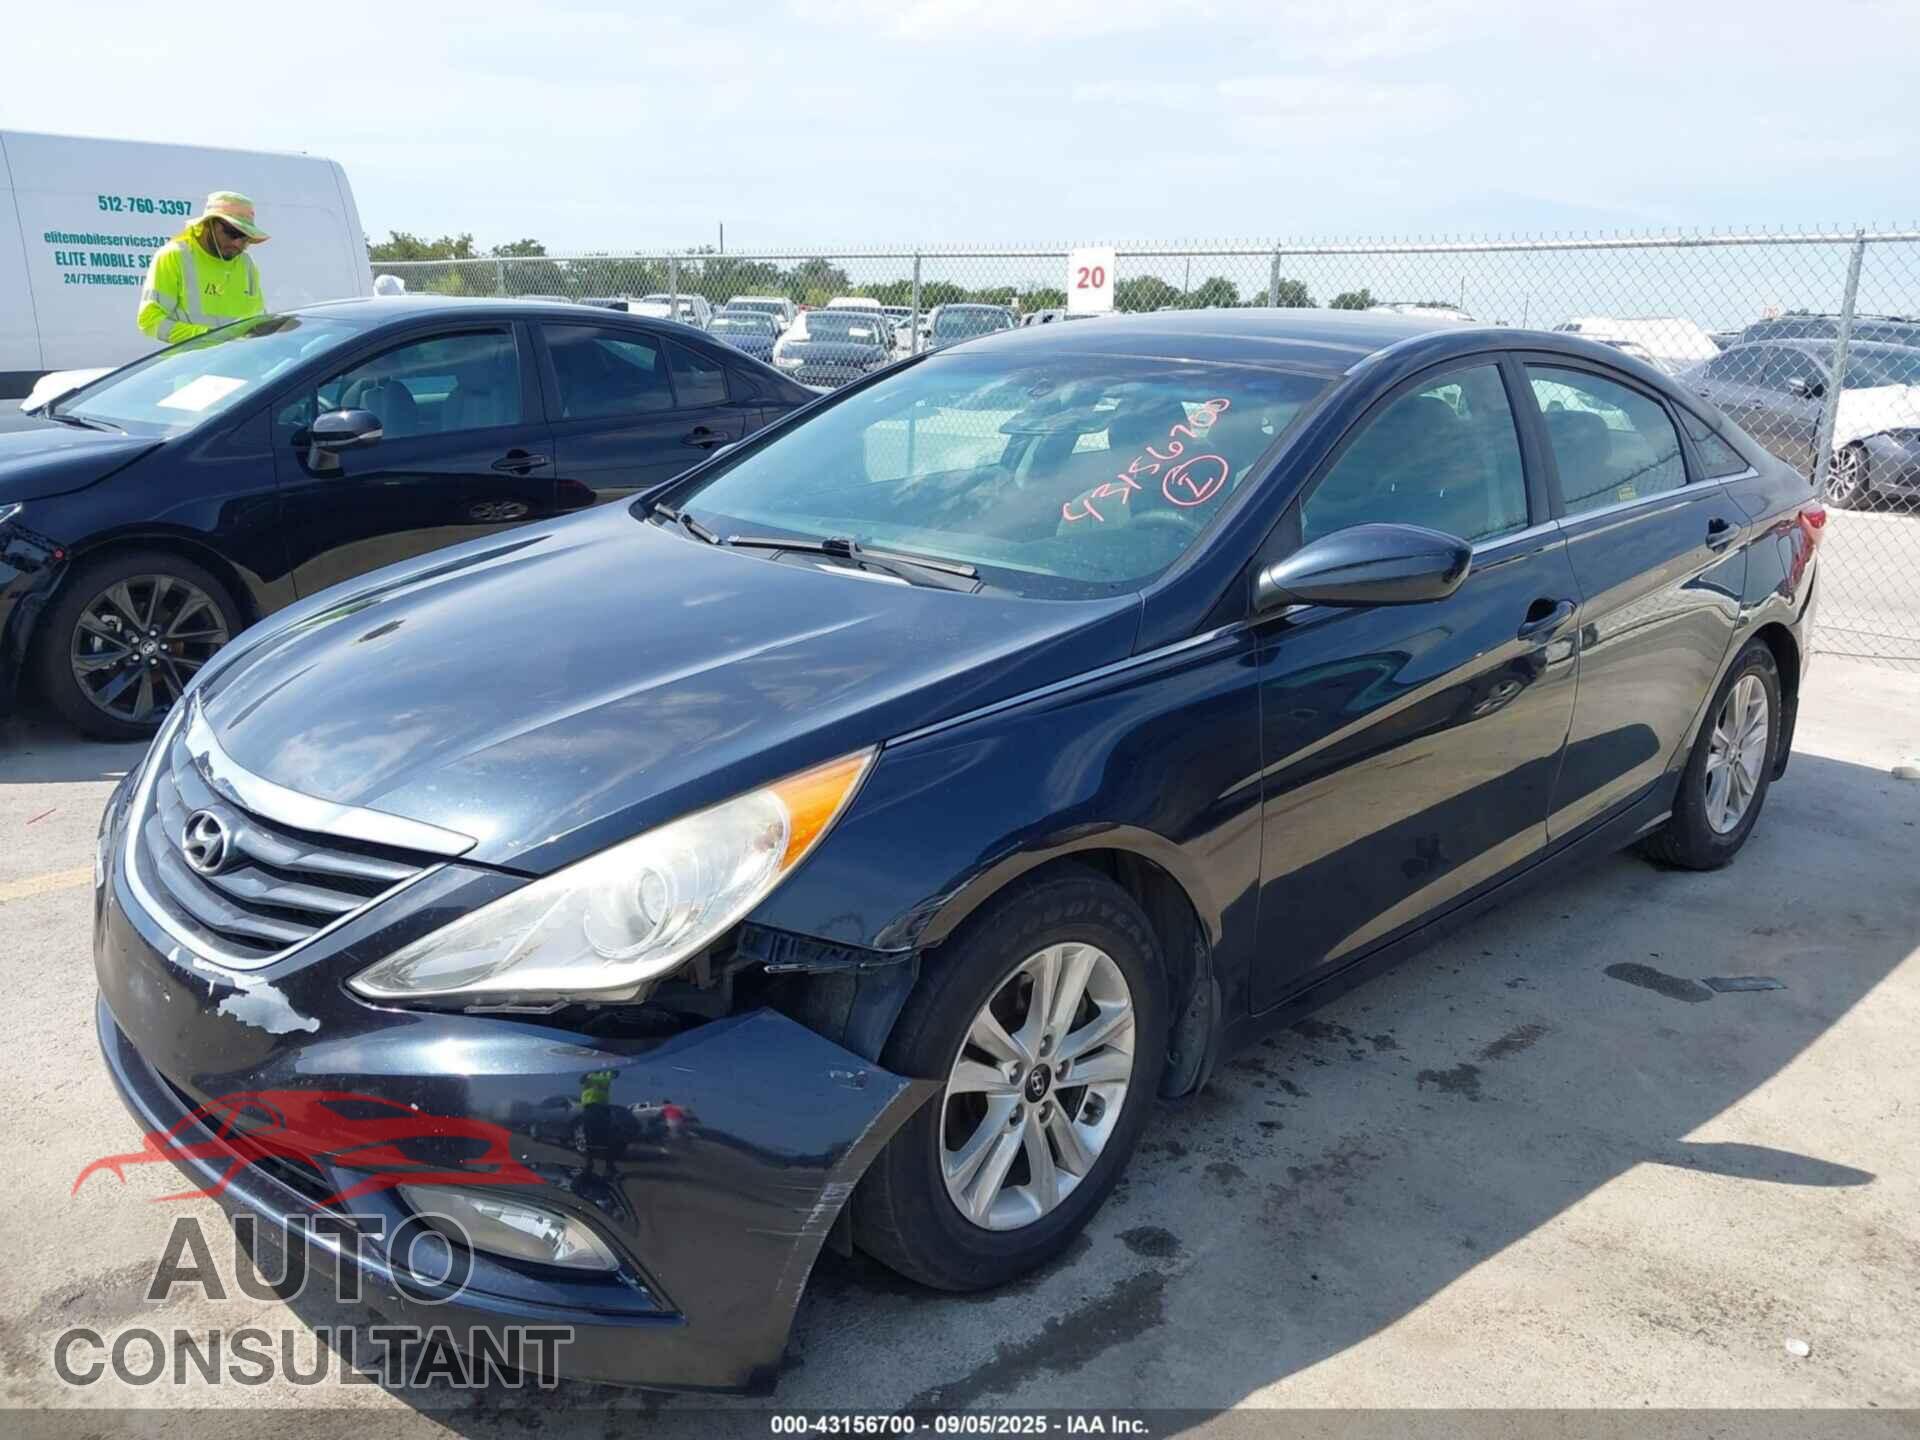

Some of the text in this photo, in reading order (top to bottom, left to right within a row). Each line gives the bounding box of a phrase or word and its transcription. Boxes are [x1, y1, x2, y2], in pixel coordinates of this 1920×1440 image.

[98, 195, 191, 216] 512-760-3397
[55, 251, 87, 266] ELITE
[90, 252, 135, 268] MOBILE
[63, 273, 147, 286] 24/7EMERGENCY/
[1077, 266, 1105, 289] 20
